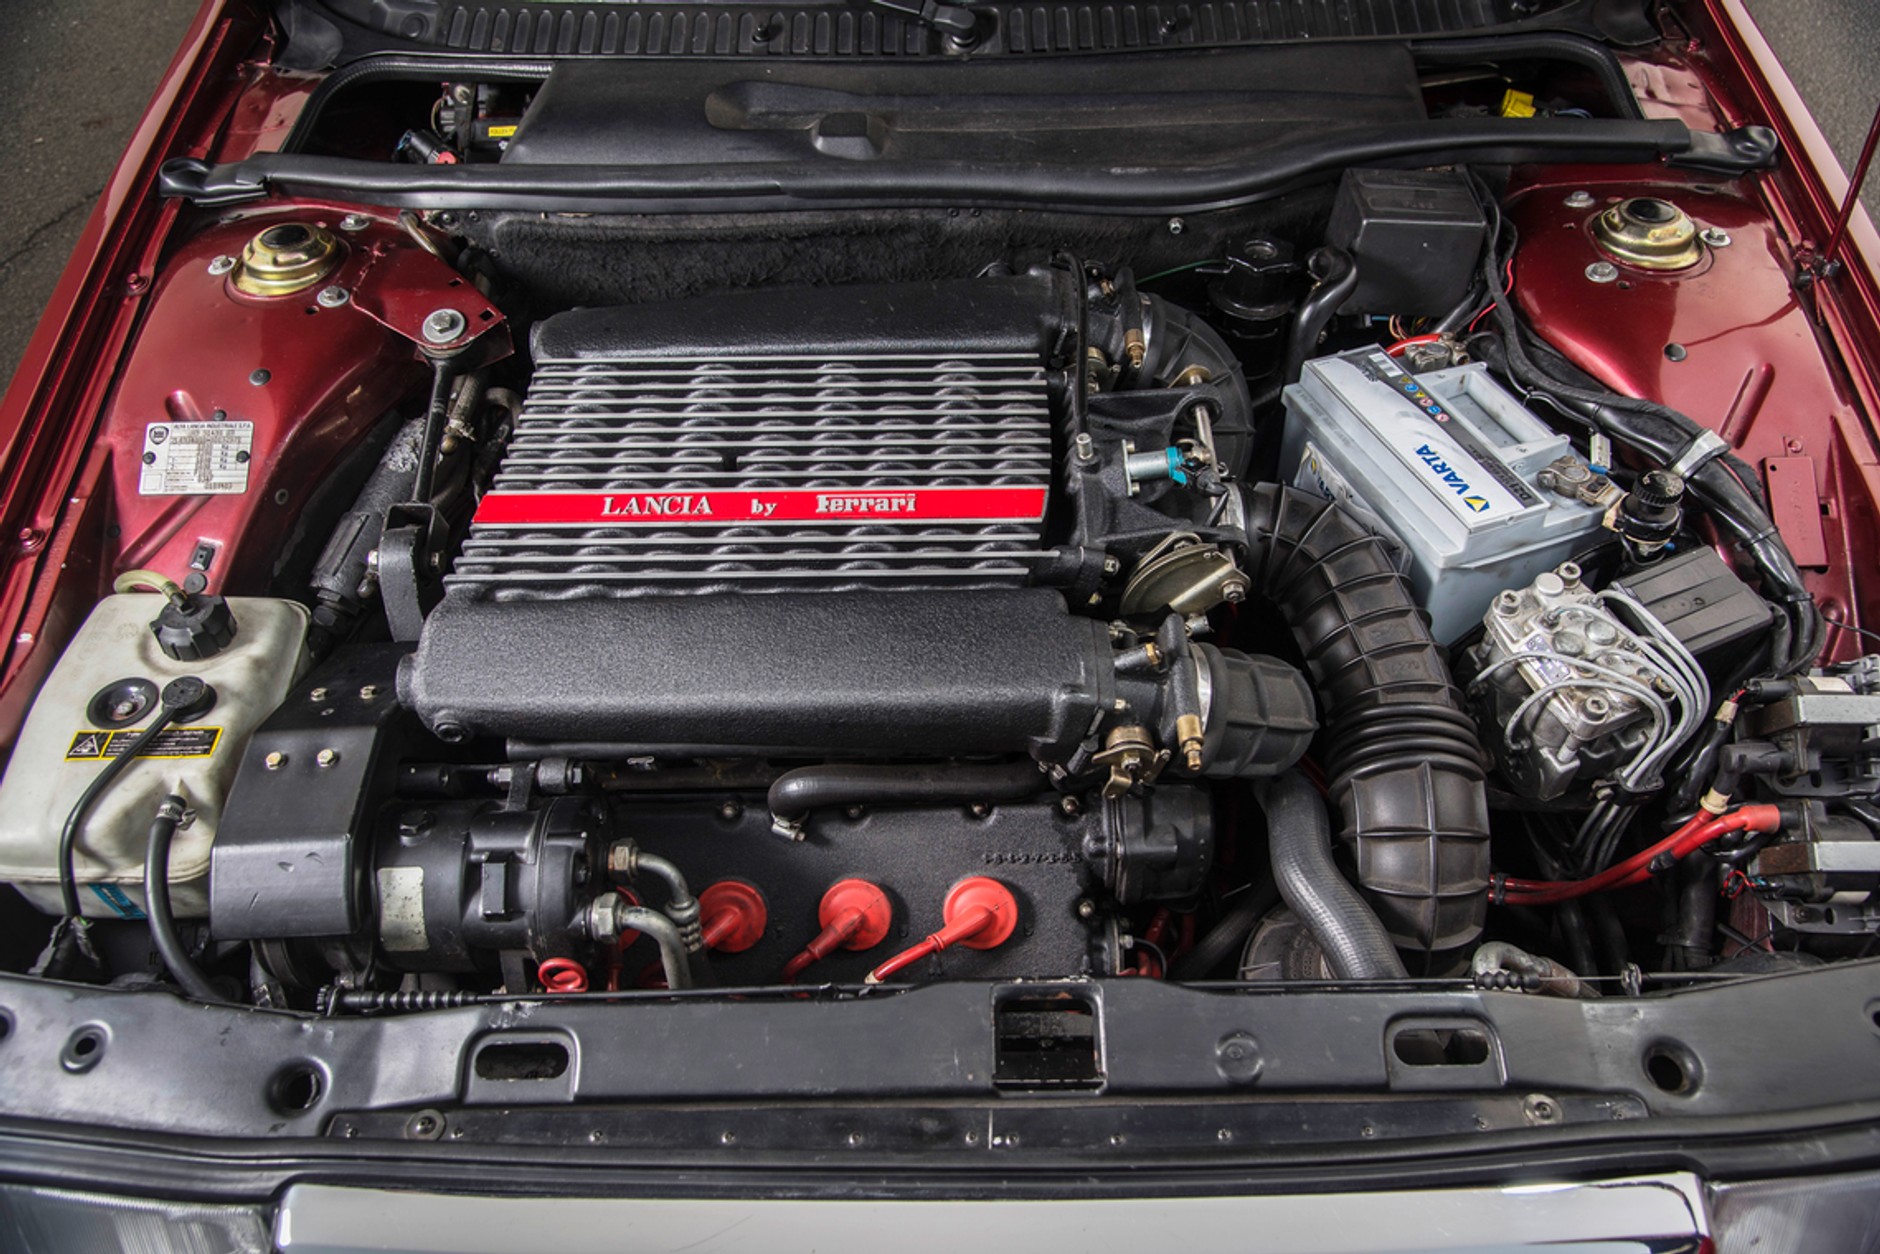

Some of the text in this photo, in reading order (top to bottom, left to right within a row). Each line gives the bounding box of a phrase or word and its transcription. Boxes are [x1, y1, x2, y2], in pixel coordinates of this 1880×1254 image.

[1416, 444, 1470, 495] VARTA
[1508, 483, 1532, 501] D21
[601, 493, 916, 517] LANCIA by Ferrari
